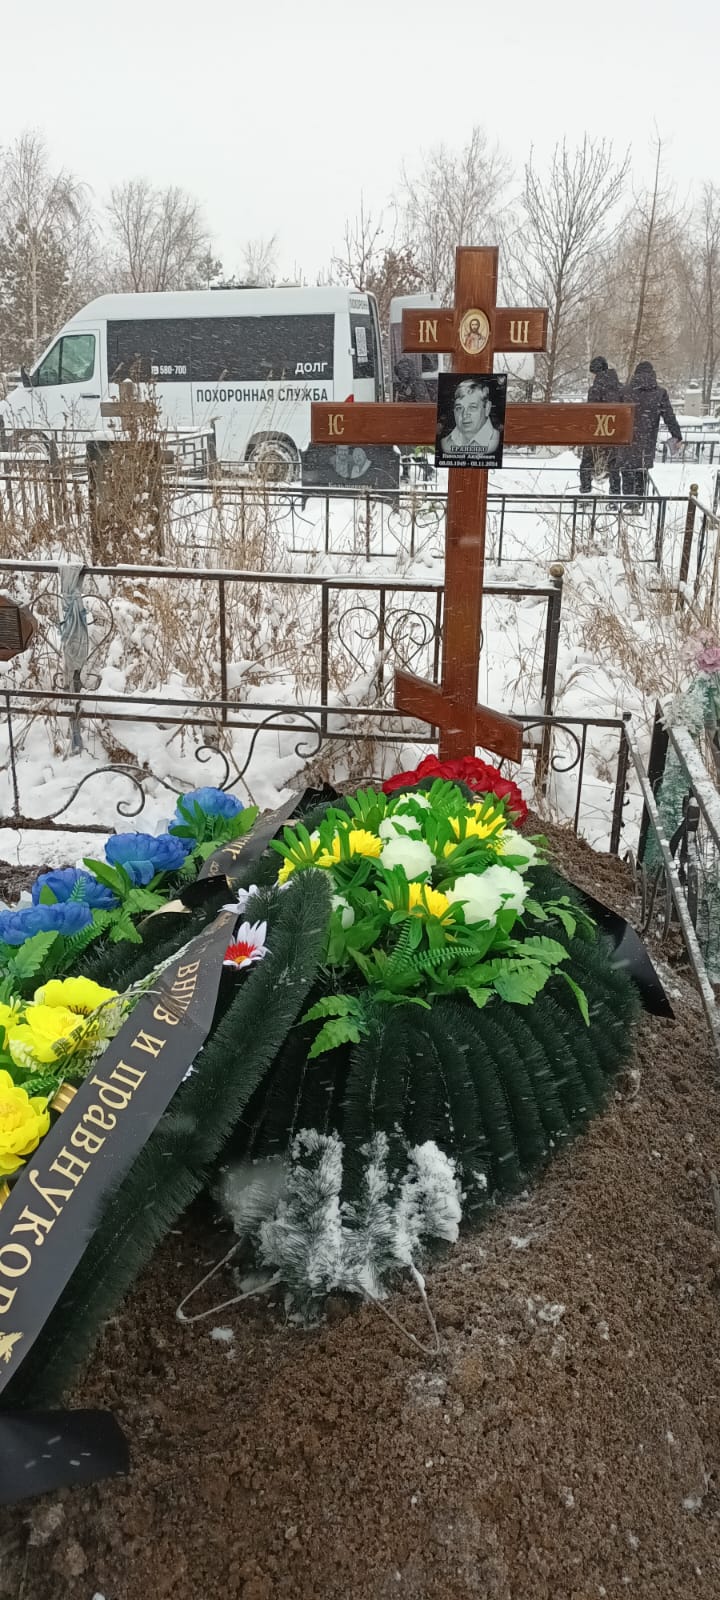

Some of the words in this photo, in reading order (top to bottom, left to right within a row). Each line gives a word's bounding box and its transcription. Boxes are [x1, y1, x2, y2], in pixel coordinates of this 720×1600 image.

[159, 365, 187, 374] 580-700
[295, 362, 328, 374] ДОЛГ
[196, 389, 274, 402] ПОХОРОННАЯ
[278, 388, 328, 401] СЛУЖБА
[130, 1029, 167, 1058] и
